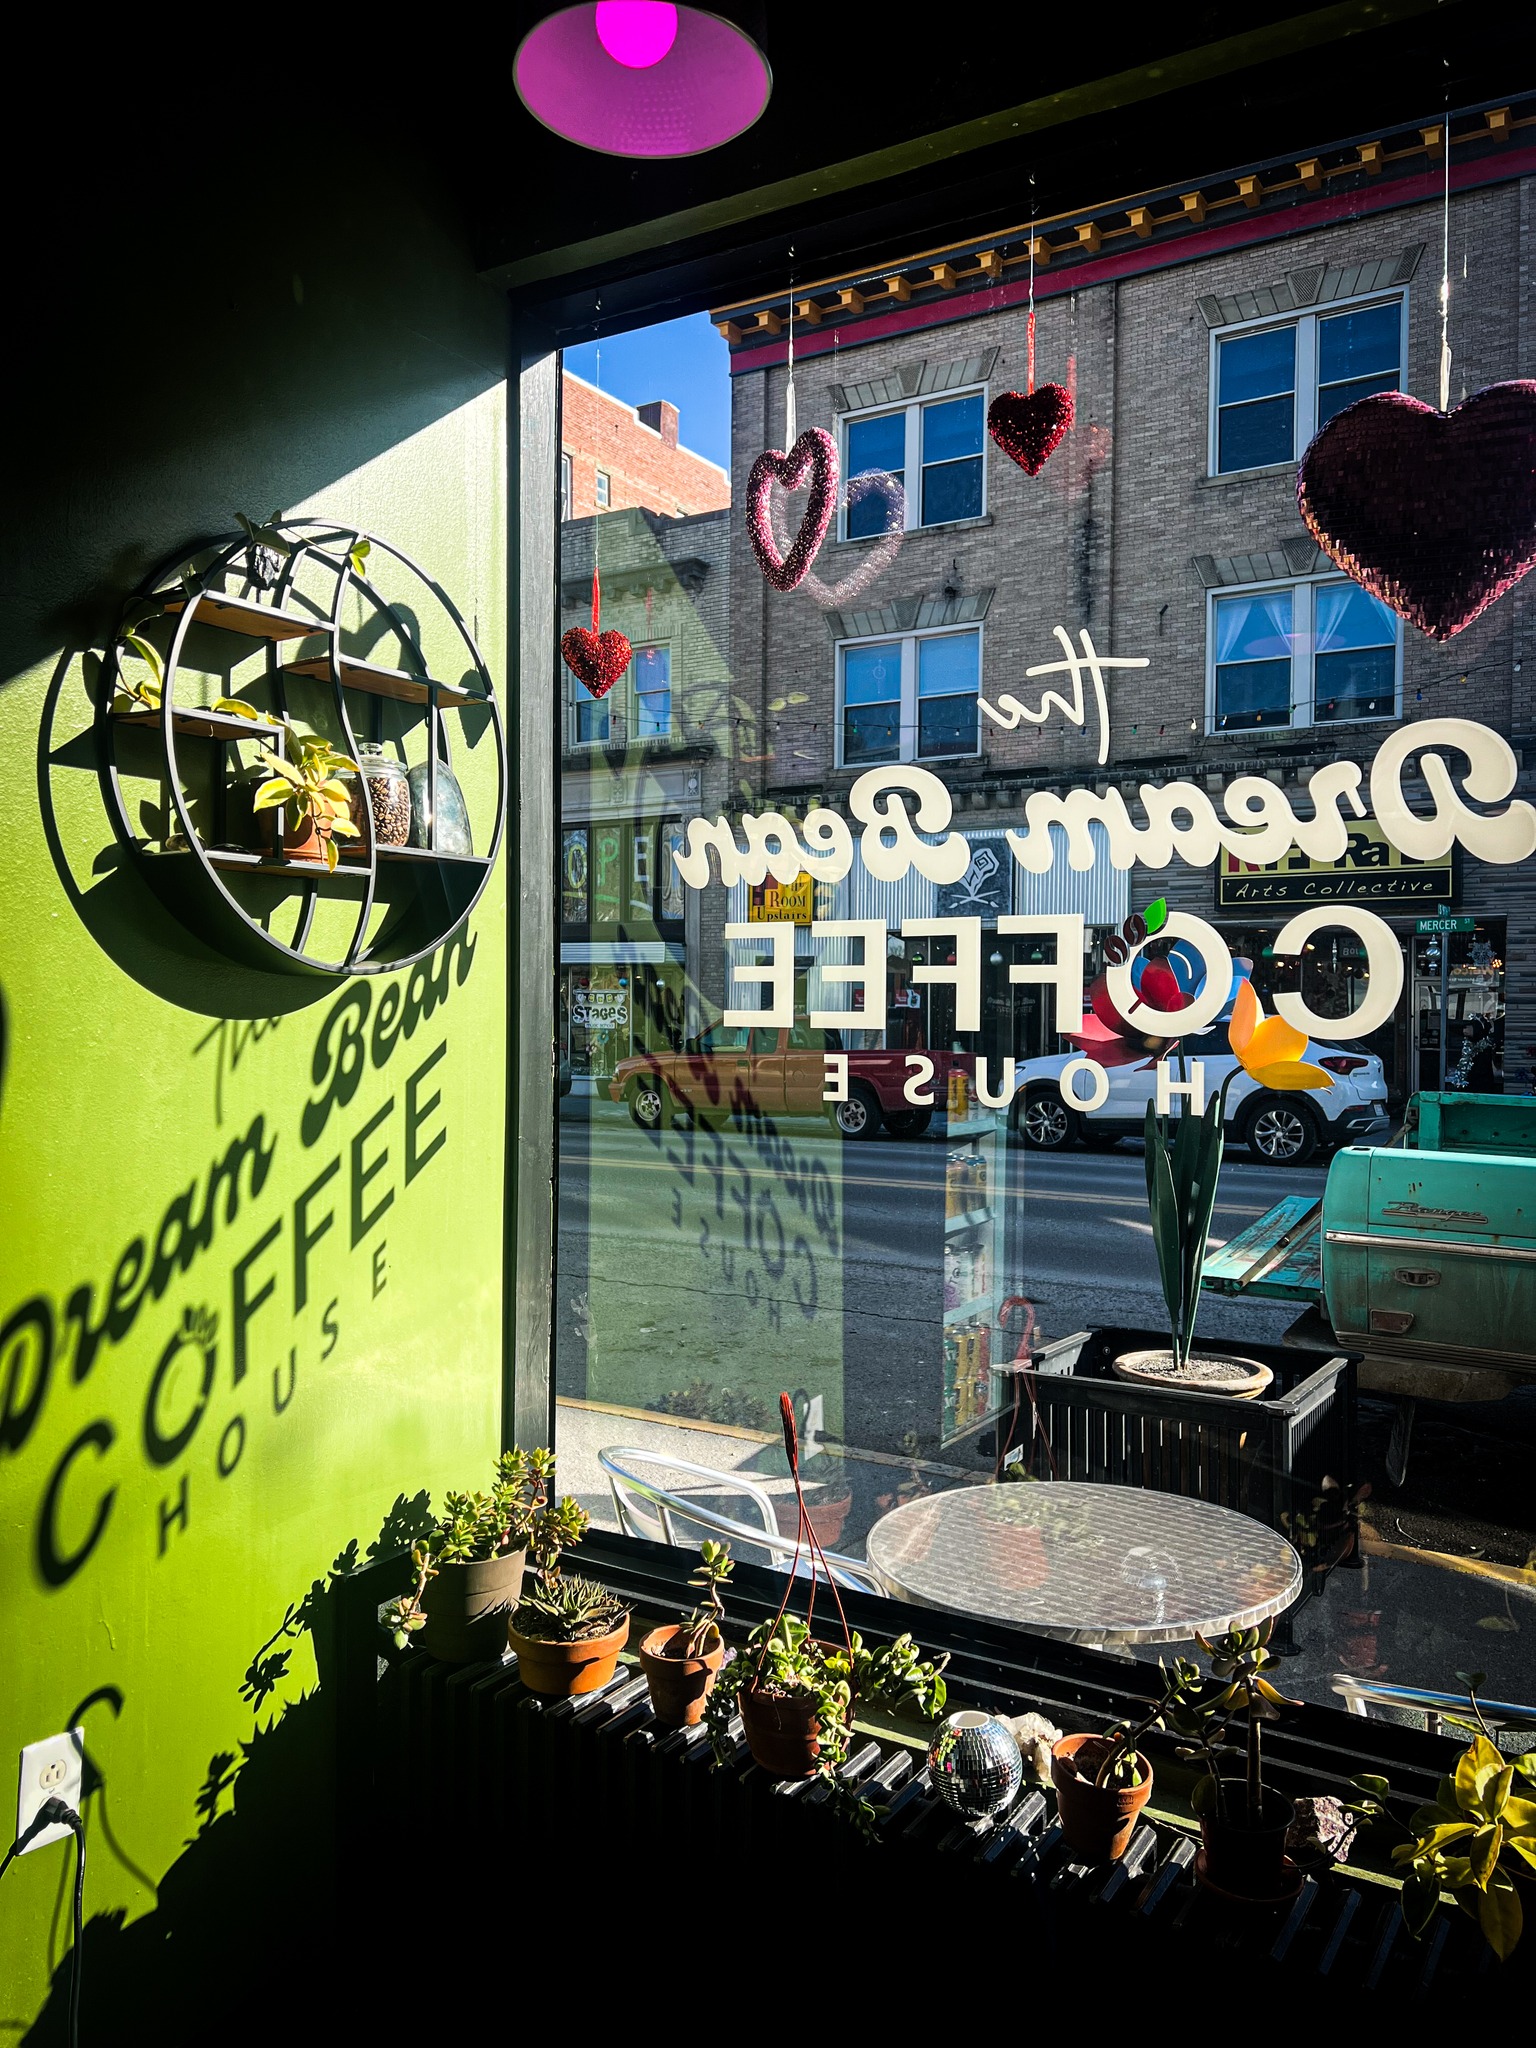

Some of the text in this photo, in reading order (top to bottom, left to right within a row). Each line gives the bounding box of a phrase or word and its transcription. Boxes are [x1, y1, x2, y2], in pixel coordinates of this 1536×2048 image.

[1235, 873, 1434, 899] Arts Collective
[770, 891, 806, 908] ROOM
[757, 906, 807, 922] Upstairs
[1420, 919, 1457, 931] MERCER
[35, 1038, 448, 1590] COFFEE
[157, 1240, 387, 1558] HOUSE
